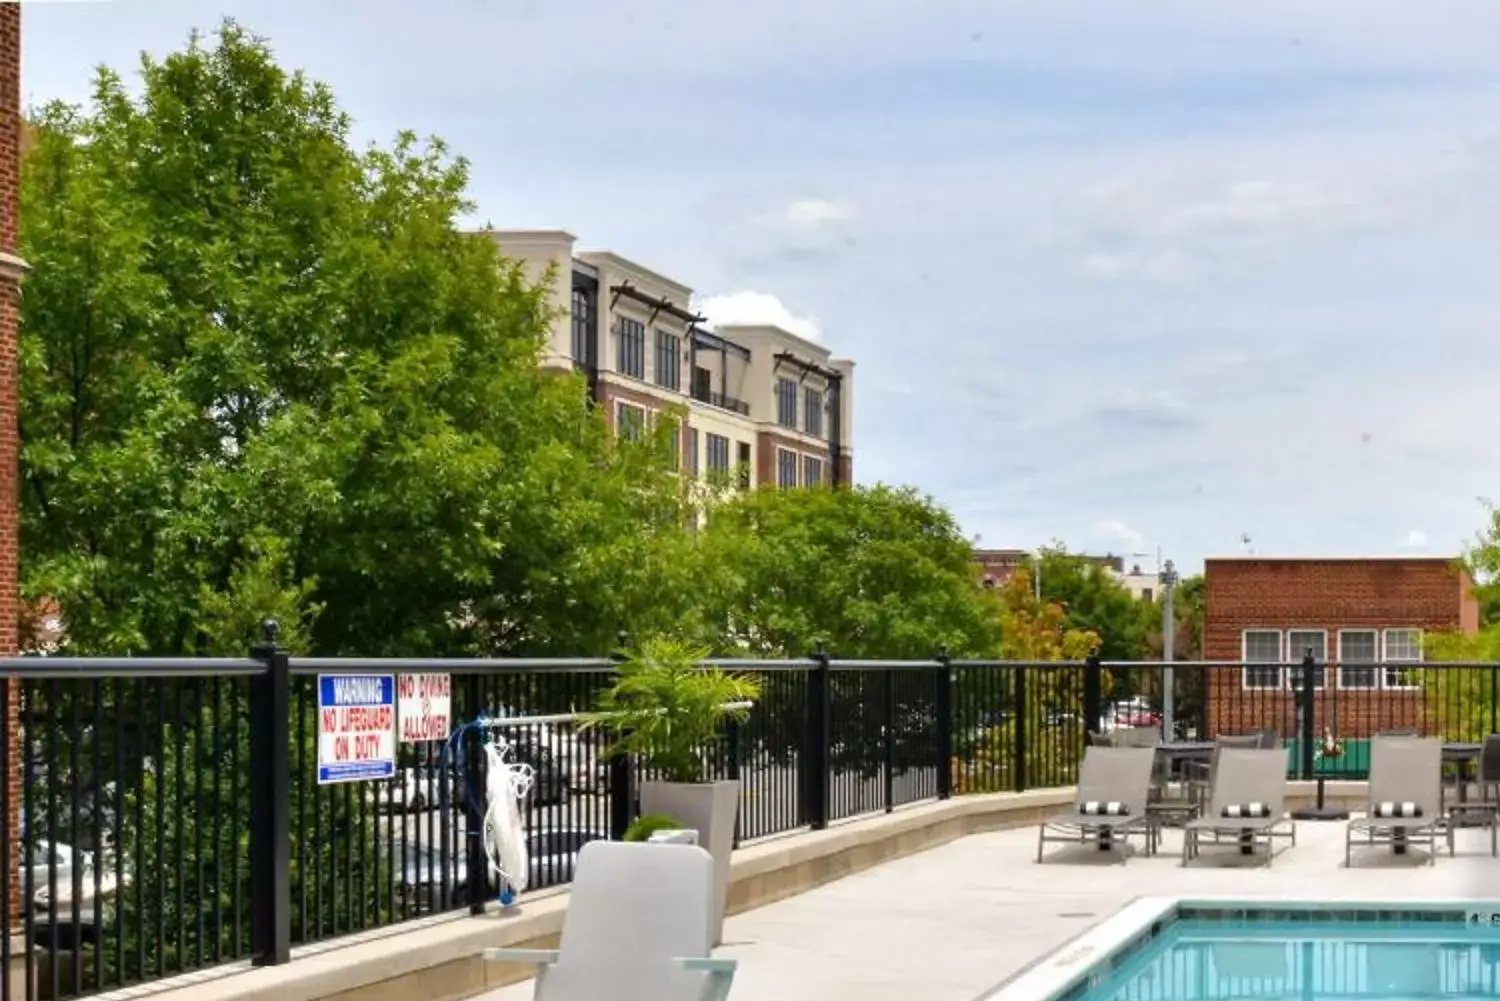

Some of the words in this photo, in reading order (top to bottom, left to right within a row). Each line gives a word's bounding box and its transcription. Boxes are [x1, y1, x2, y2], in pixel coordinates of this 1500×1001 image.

[333, 677, 383, 704] WARNING
[399, 675, 414, 698] NO
[323, 709, 336, 733] NO
[341, 707, 391, 733] LIFEGUARD
[404, 715, 446, 738] ALLOWED
[333, 737, 349, 760] ON
[355, 735, 381, 759] DUTY
